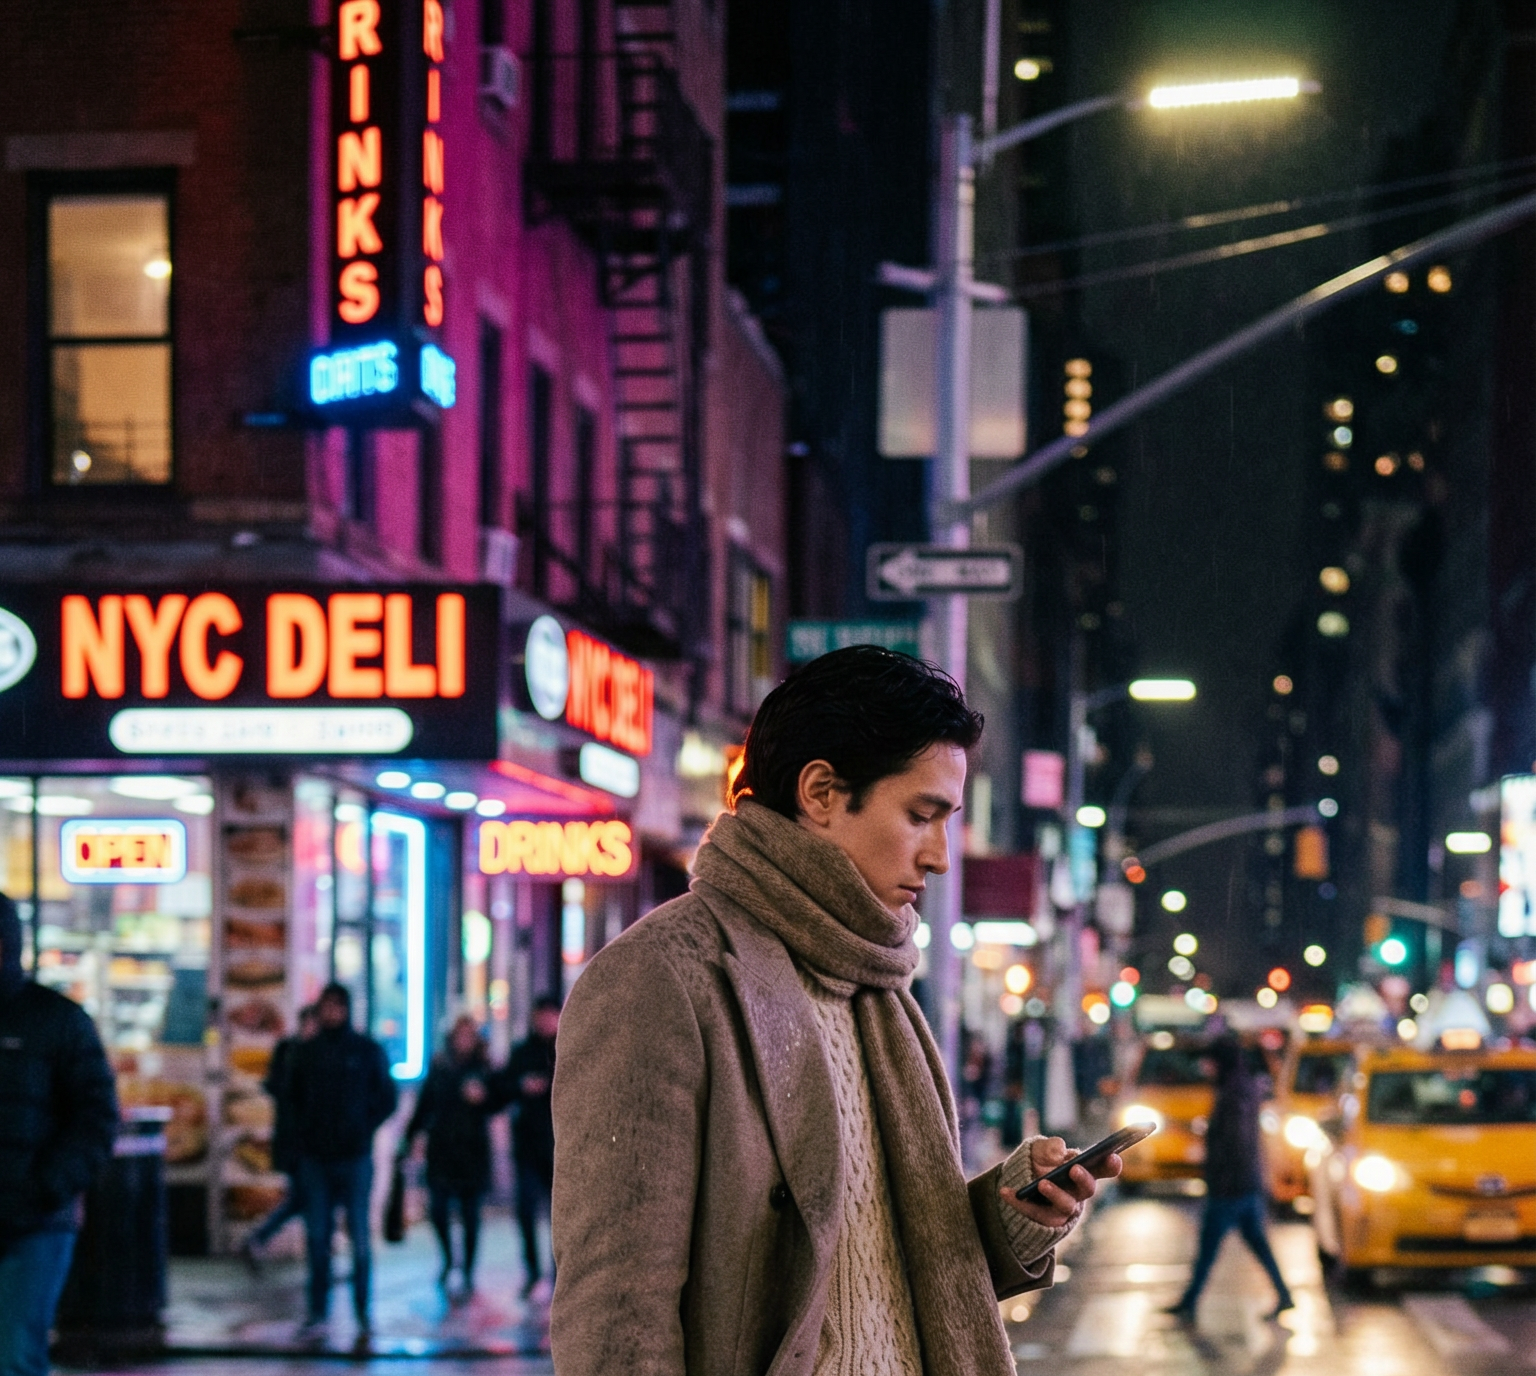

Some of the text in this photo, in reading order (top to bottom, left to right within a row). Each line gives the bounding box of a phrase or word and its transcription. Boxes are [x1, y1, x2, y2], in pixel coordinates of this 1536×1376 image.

[61, 592, 243, 700] NYC
[266, 593, 465, 698] DELI
[73, 829, 175, 872] OPEN
[479, 820, 632, 876] DRINKS
